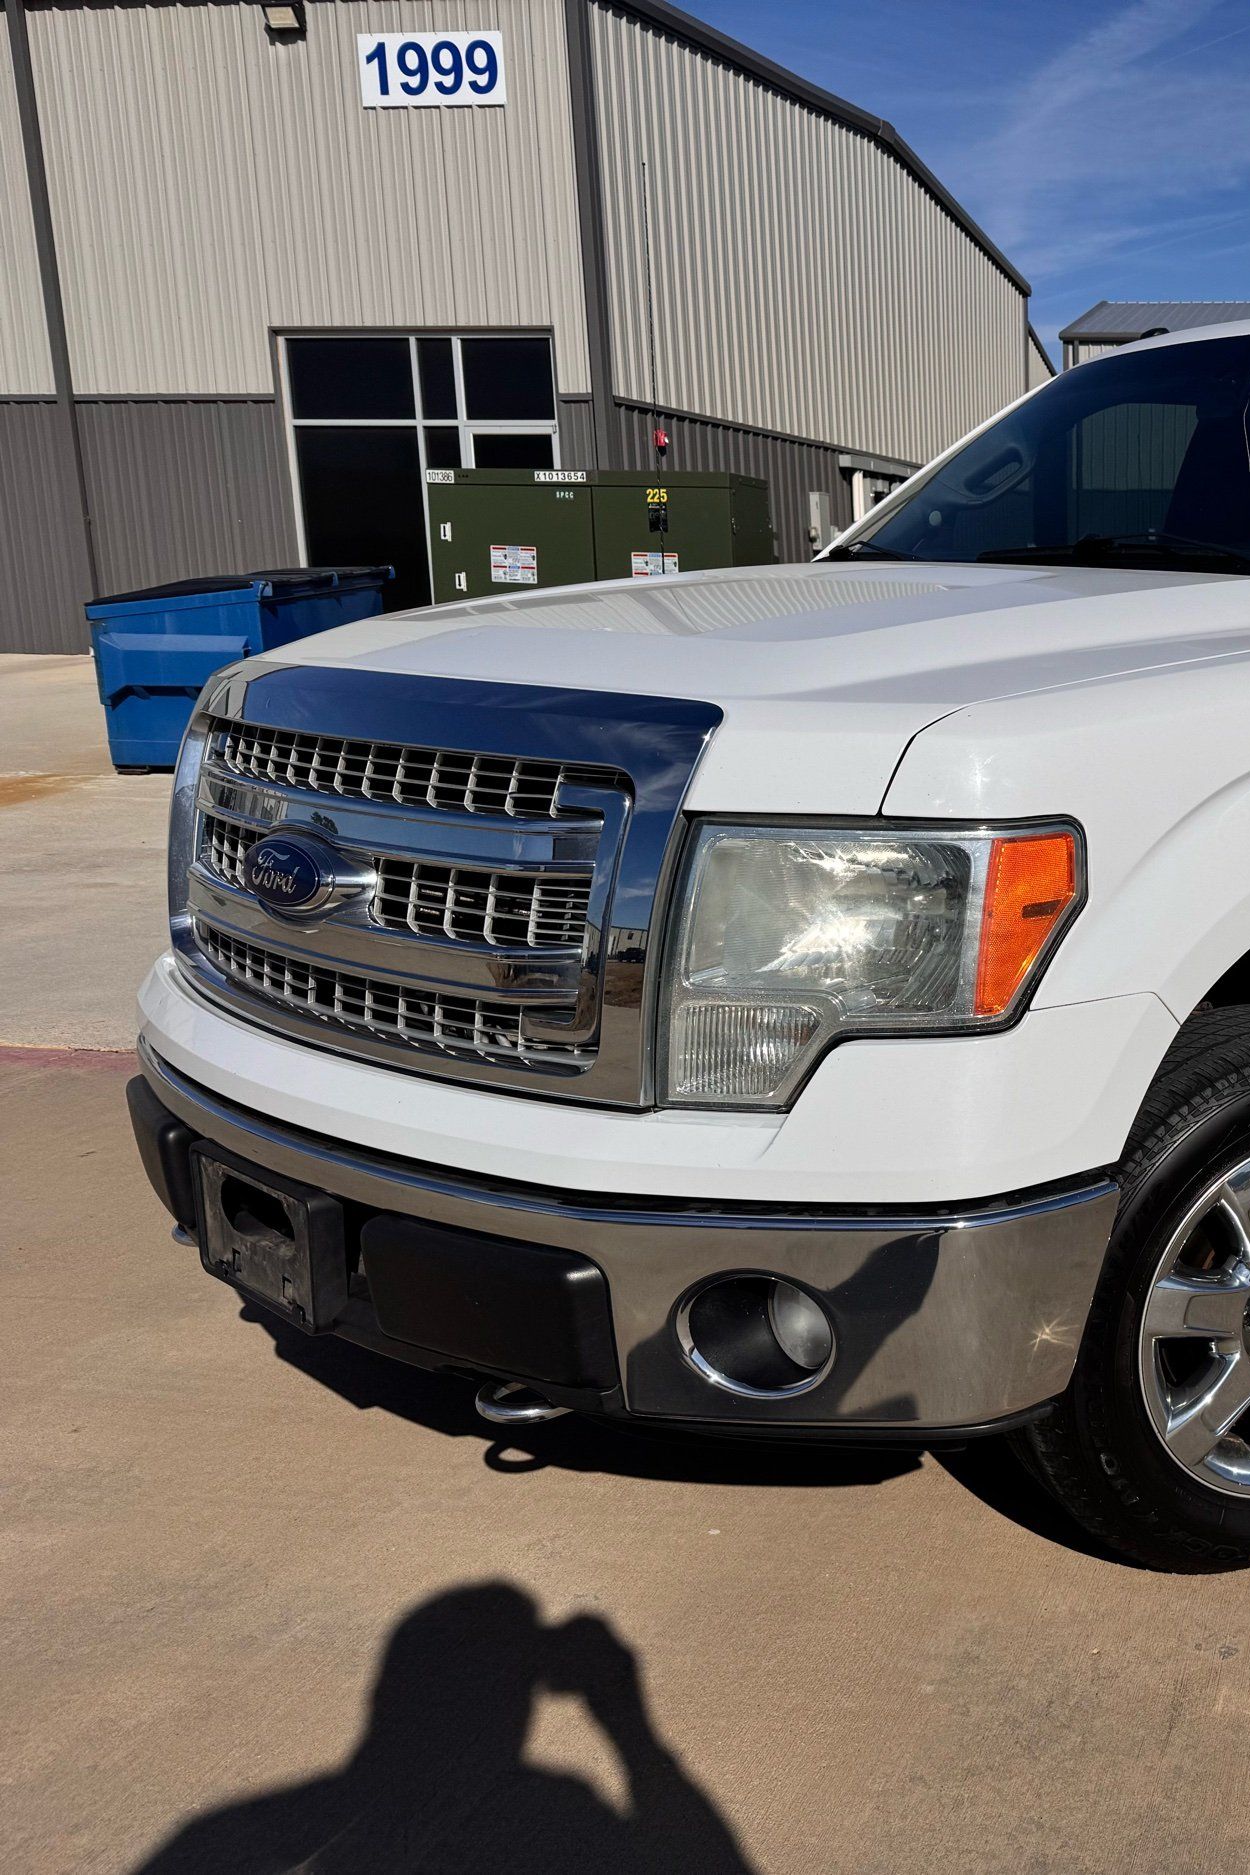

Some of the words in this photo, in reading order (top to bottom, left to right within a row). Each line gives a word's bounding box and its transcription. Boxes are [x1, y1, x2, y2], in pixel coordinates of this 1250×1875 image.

[365, 39, 498, 96] 1999
[535, 472, 585, 481] X1013654
[646, 488, 668, 503] 225
[252, 848, 300, 893] Ford
